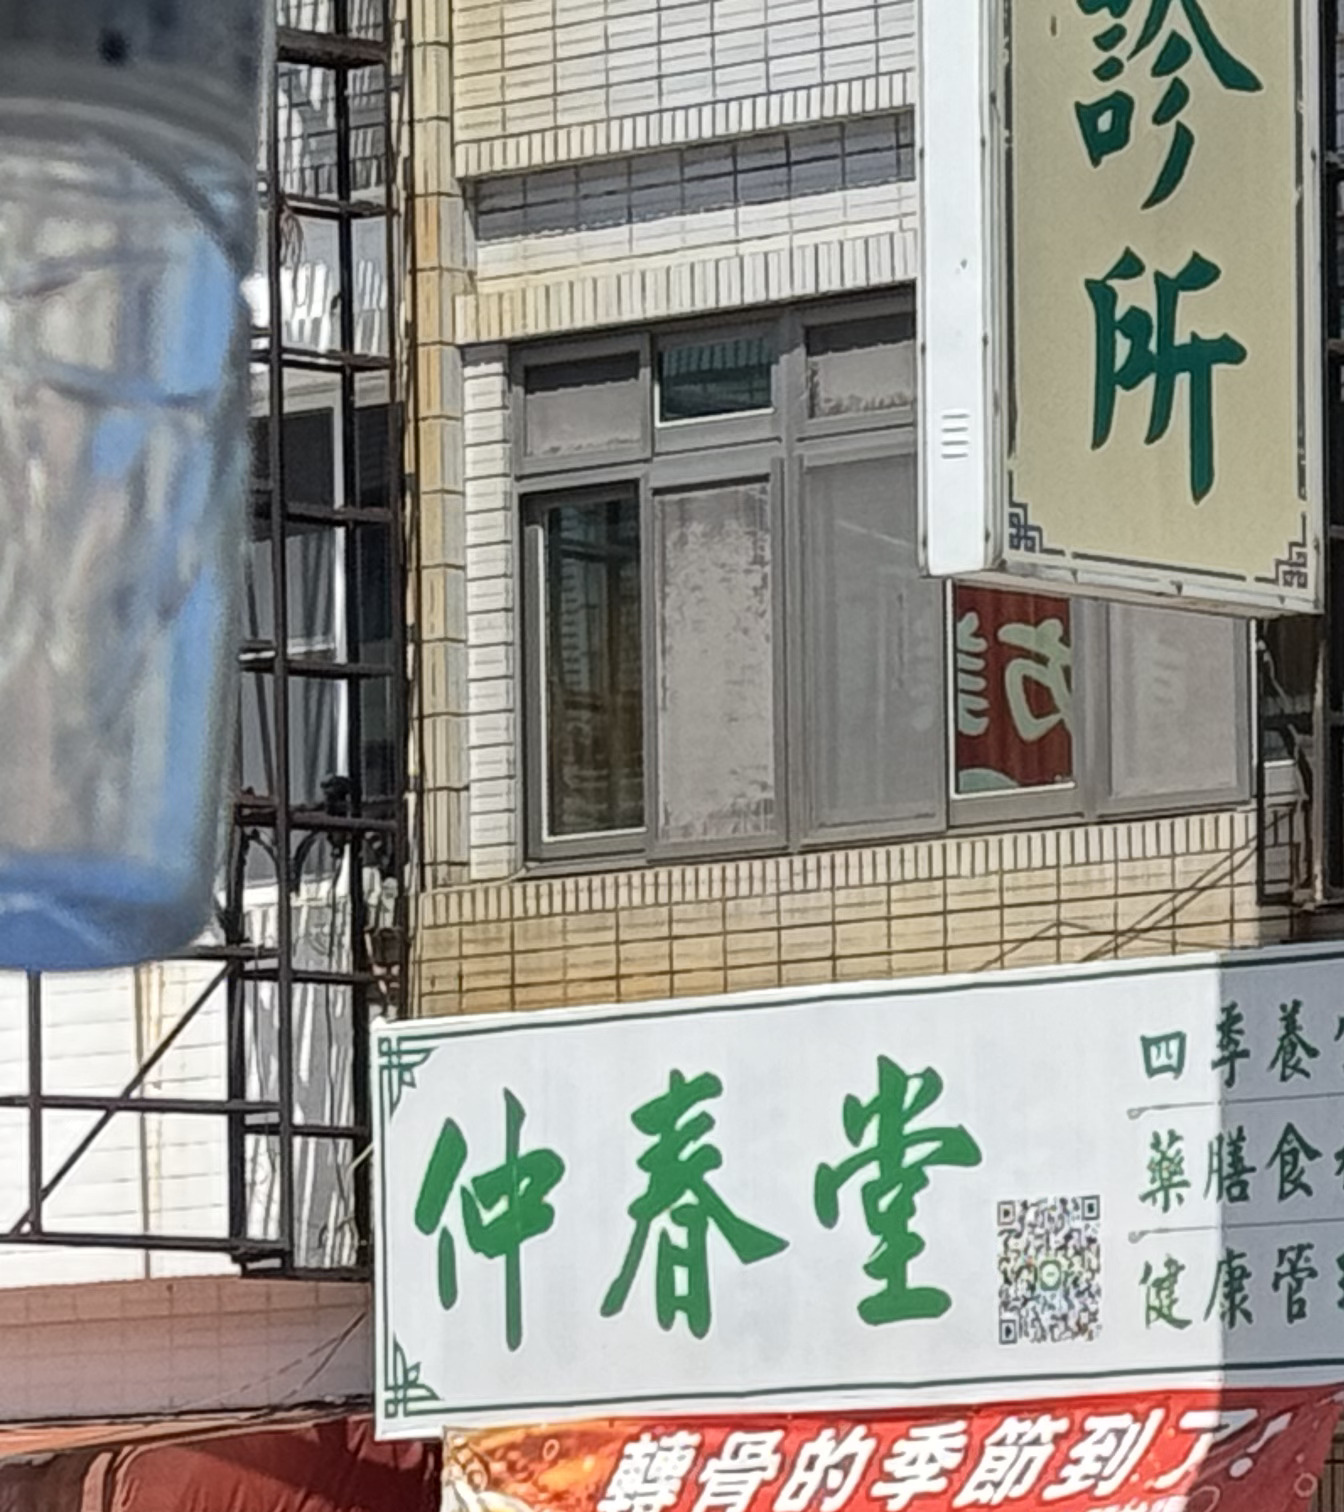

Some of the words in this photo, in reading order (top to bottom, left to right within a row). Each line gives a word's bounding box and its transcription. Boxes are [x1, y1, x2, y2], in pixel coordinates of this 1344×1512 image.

[1074, 0, 1264, 505] 診所
[414, 1053, 984, 1352] 仲春堂
